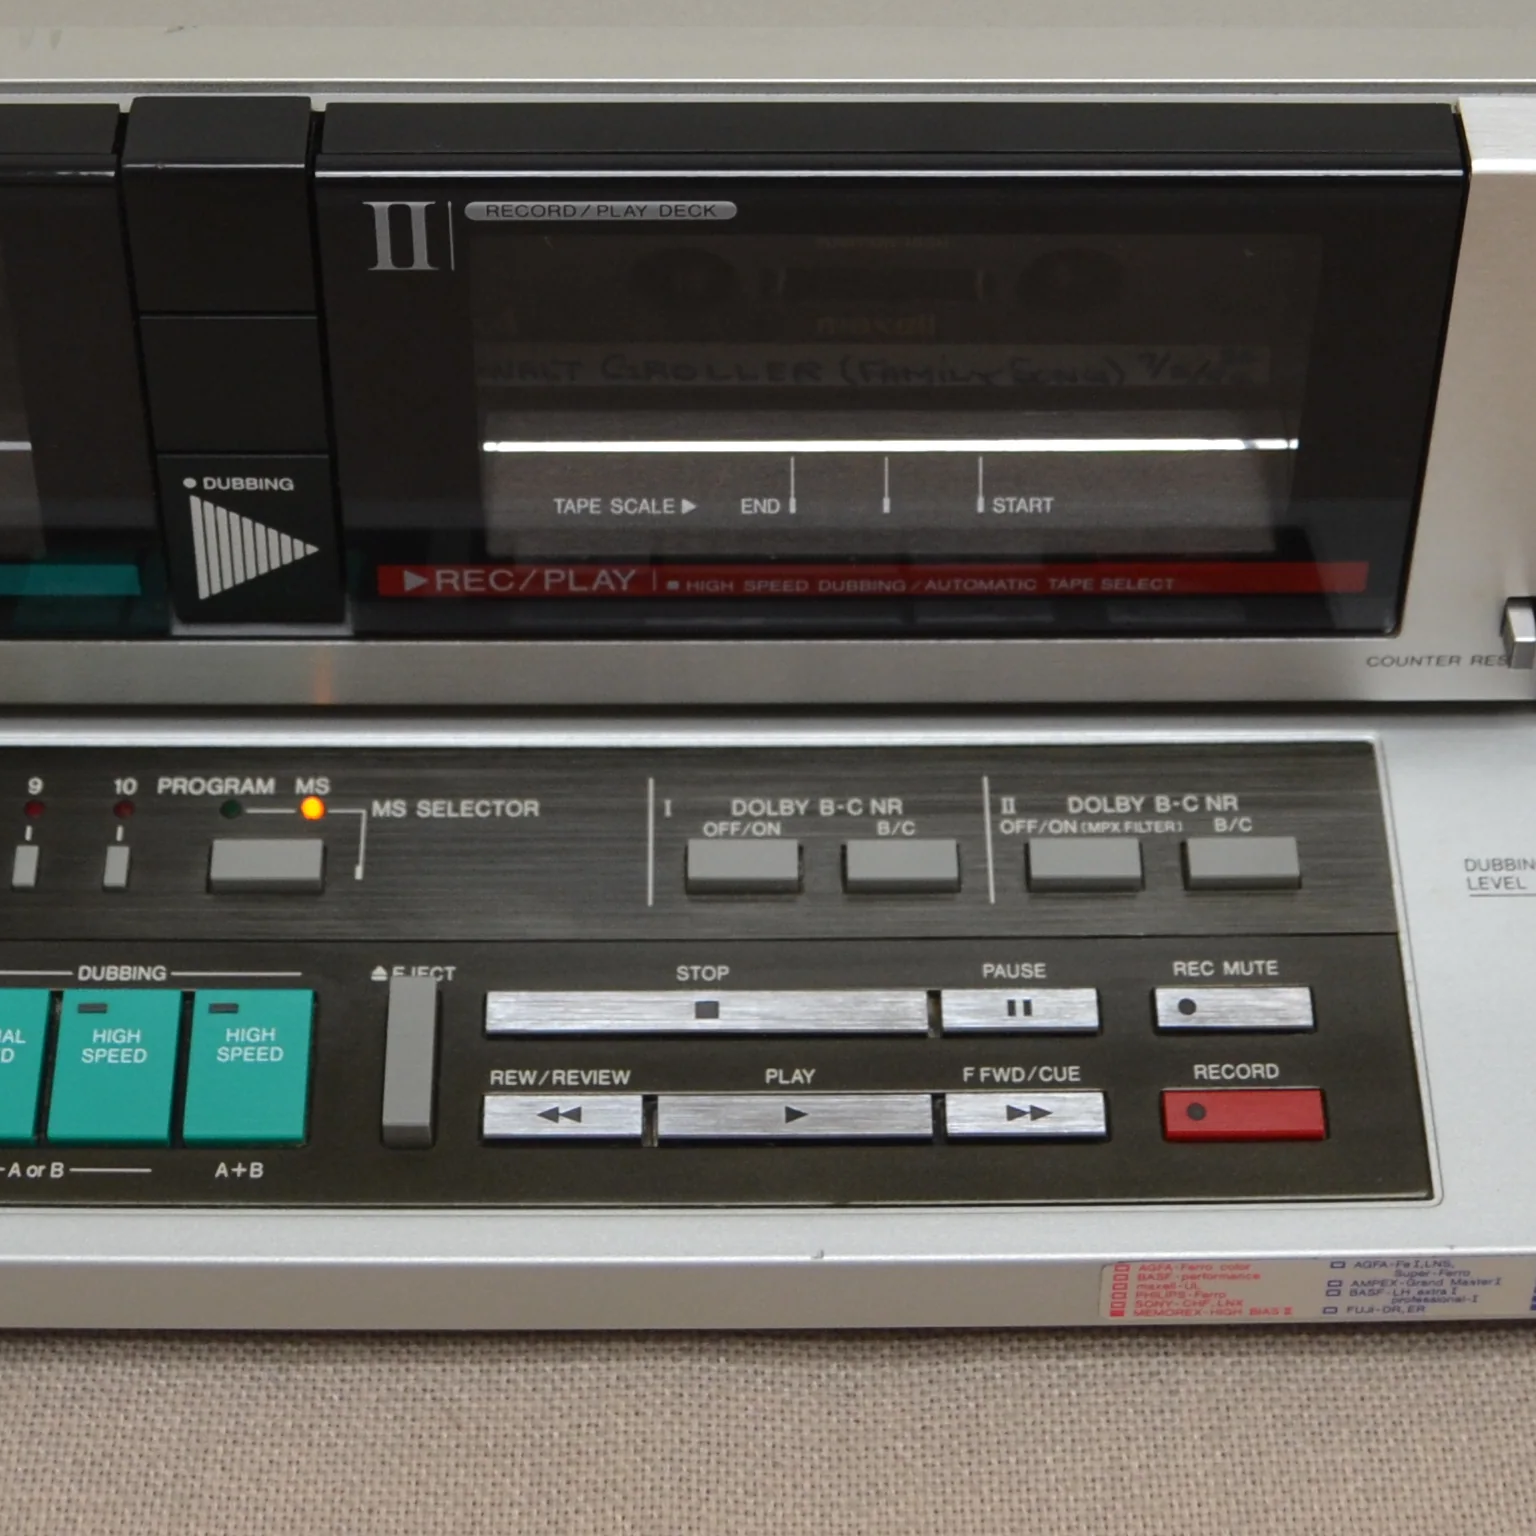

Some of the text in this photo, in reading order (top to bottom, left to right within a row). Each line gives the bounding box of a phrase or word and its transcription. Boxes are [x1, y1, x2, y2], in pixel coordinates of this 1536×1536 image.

[659, 204, 717, 219] DECK
[362, 200, 440, 271] II
[202, 476, 295, 493] DUBBING
[553, 498, 676, 515] TAPE SCALE
[740, 498, 781, 515] END
[992, 496, 1054, 514] START
[435, 569, 637, 592] REC/PLAY
[685, 577, 1175, 593] HIGH SPEED TAPE SELECT
[1366, 654, 1509, 668] COUNTER RES
[27, 777, 43, 795] 9
[114, 777, 137, 795] 10
[157, 777, 330, 796] PROGRAM MS
[371, 800, 540, 818] MS SELECTOR
[731, 798, 810, 817] DOLBY
[870, 798, 903, 816] NR
[1067, 795, 1146, 815] DOLBY
[1205, 794, 1239, 813] NR
[702, 820, 782, 838] OFF/ON
[876, 819, 916, 838] B/C
[999, 818, 1078, 836] OFF/ON
[1213, 816, 1254, 834] B/C
[1466, 875, 1528, 891] LEVEL
[77, 965, 167, 983] DUBBING
[676, 965, 730, 983] STOP
[982, 962, 1047, 980] PAUSE
[1173, 959, 1279, 977] REC MUTE
[91, 1027, 142, 1045] HIGH
[225, 1026, 277, 1044] HIGH
[81, 1046, 149, 1064] SPEED
[216, 1045, 285, 1063] SPEED
[489, 1069, 632, 1087] REW/REVIEW
[765, 1068, 817, 1086] PLAY
[979, 1065, 1082, 1083] FWD/CUE
[1193, 1063, 1280, 1081] RECORD
[7, 1161, 65, 1180] A or B
[214, 1161, 265, 1180] A+B
